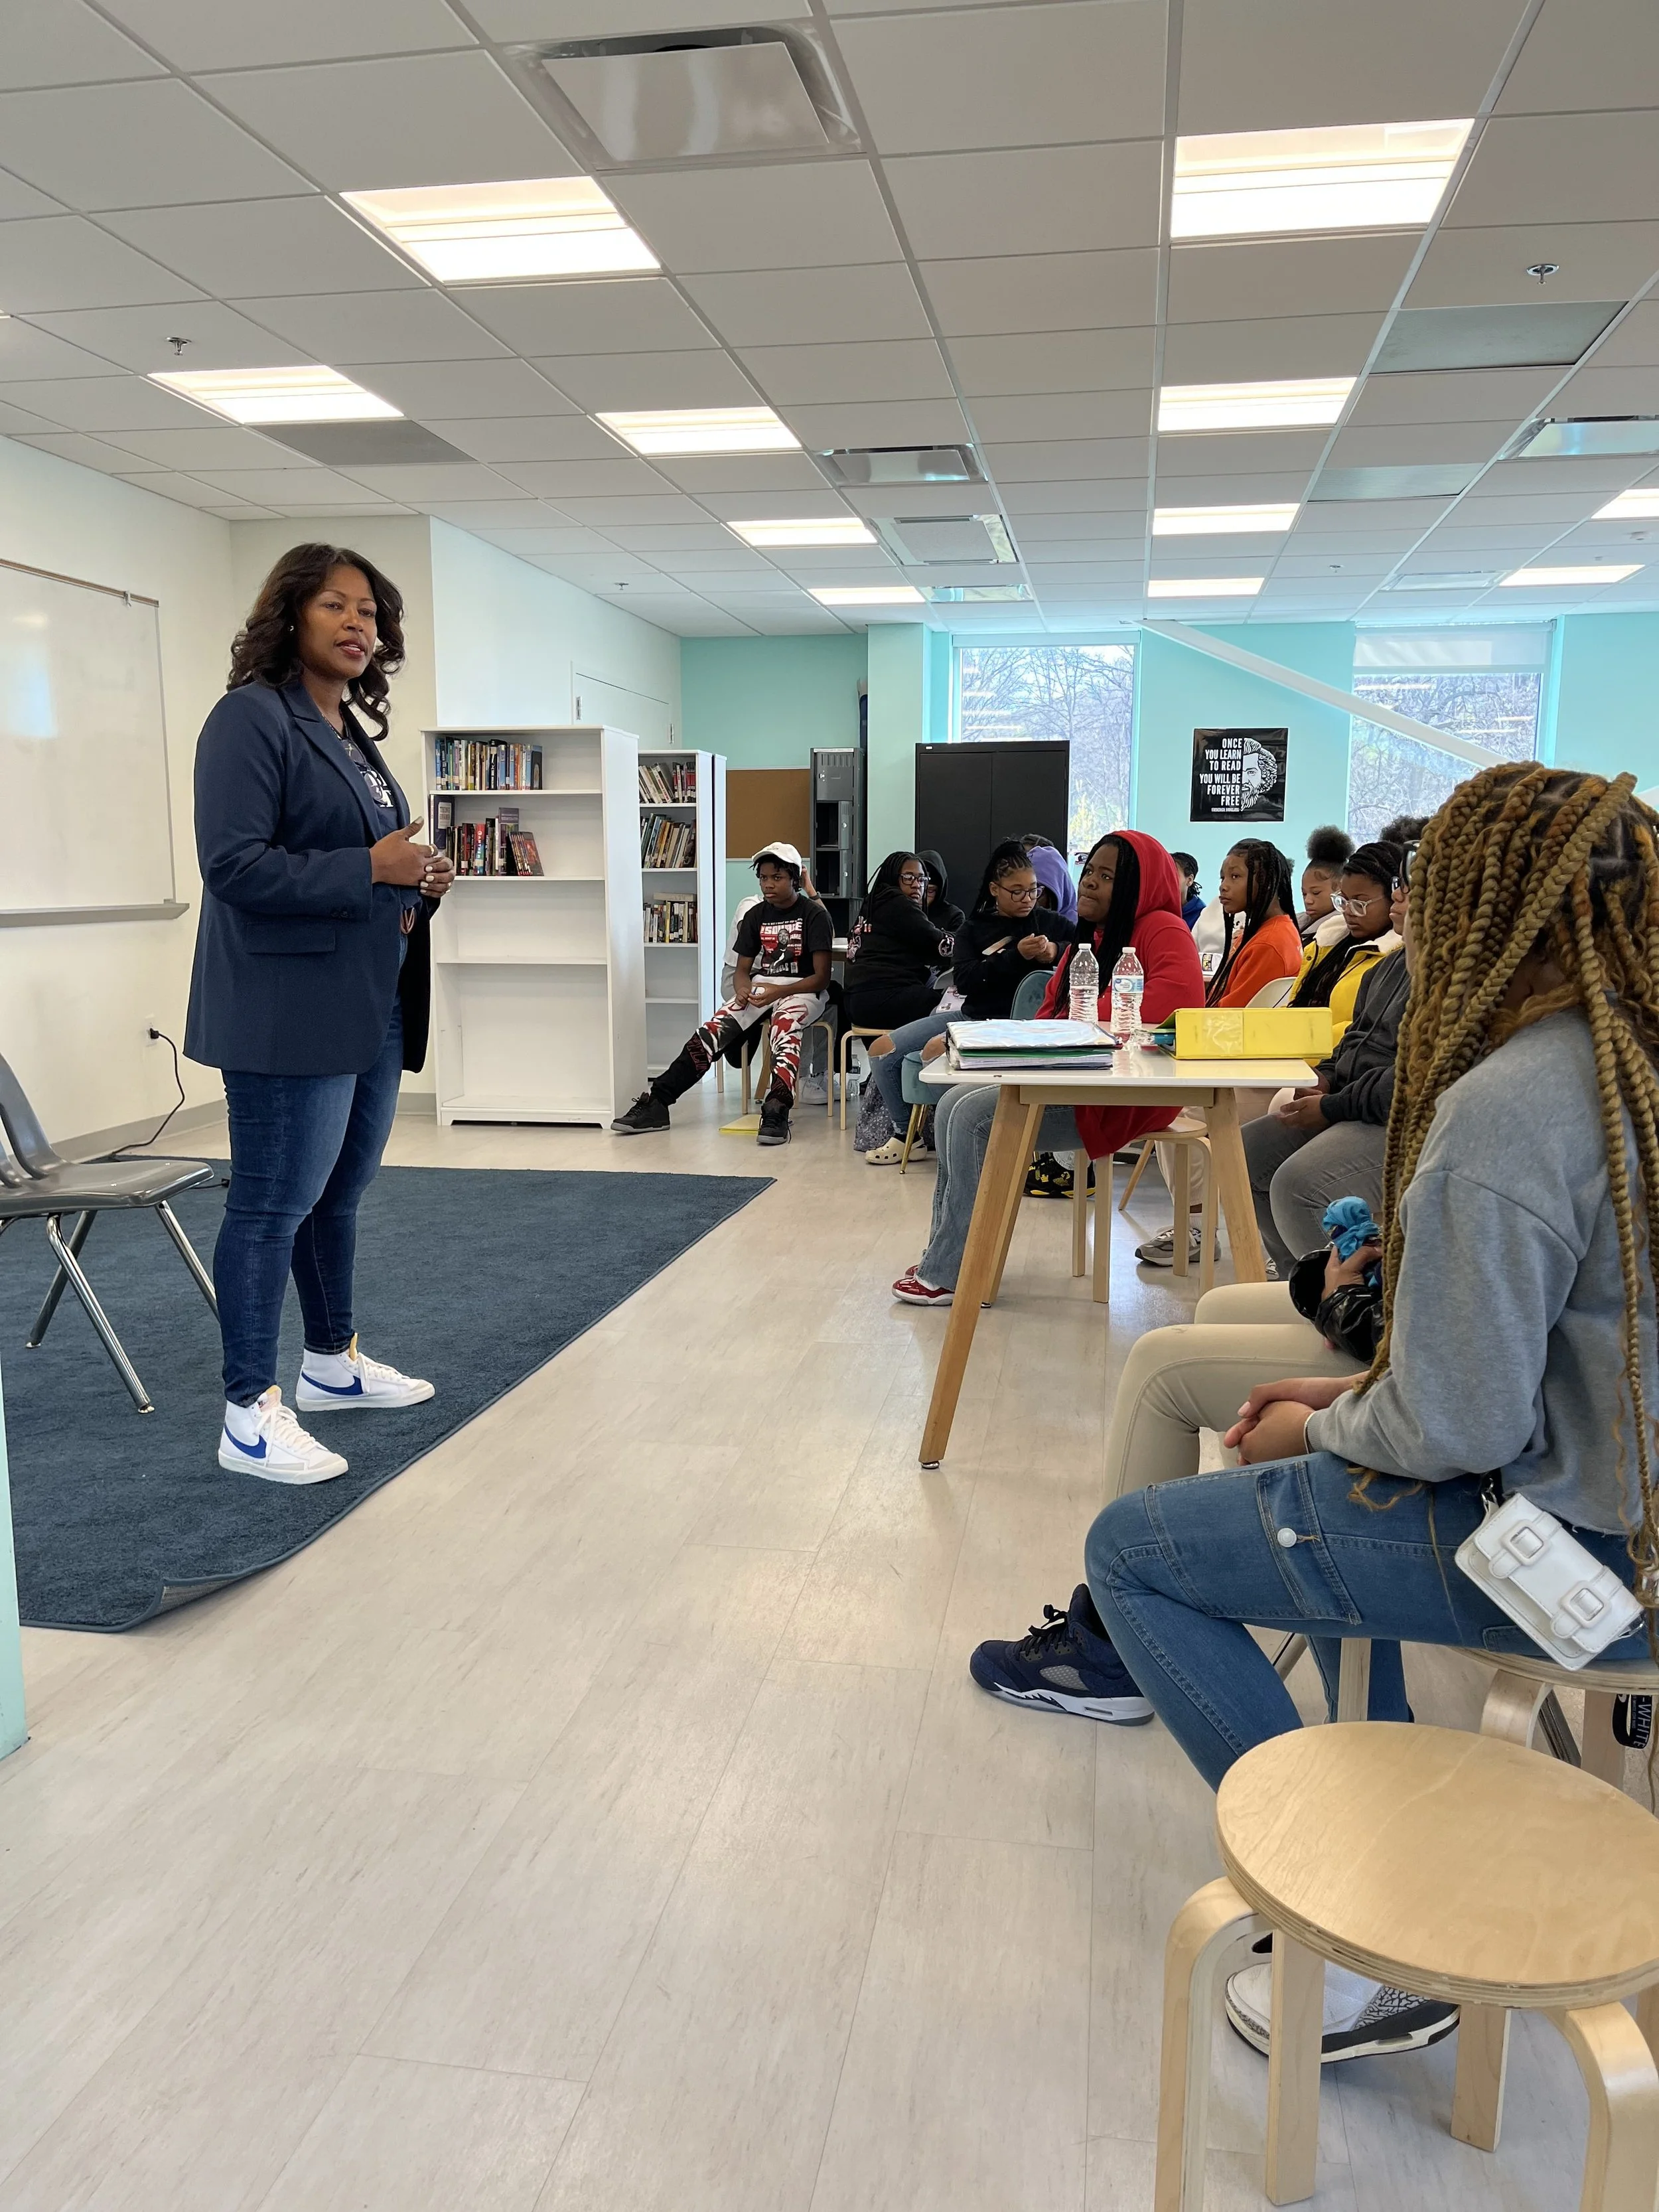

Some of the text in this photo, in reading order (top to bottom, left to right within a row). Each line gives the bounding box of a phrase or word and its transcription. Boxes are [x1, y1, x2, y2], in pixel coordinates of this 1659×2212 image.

[1222, 738, 1242, 749] ONCE
[1205, 749, 1242, 760] YOU LEARN
[1209, 761, 1241, 771] TO READ
[1199, 773, 1240, 784] YOU WILL BE
[1207, 784, 1240, 795] FOREVER
[1220, 796, 1240, 806] FREE
[1632, 1696, 1652, 1748] -WHITE
